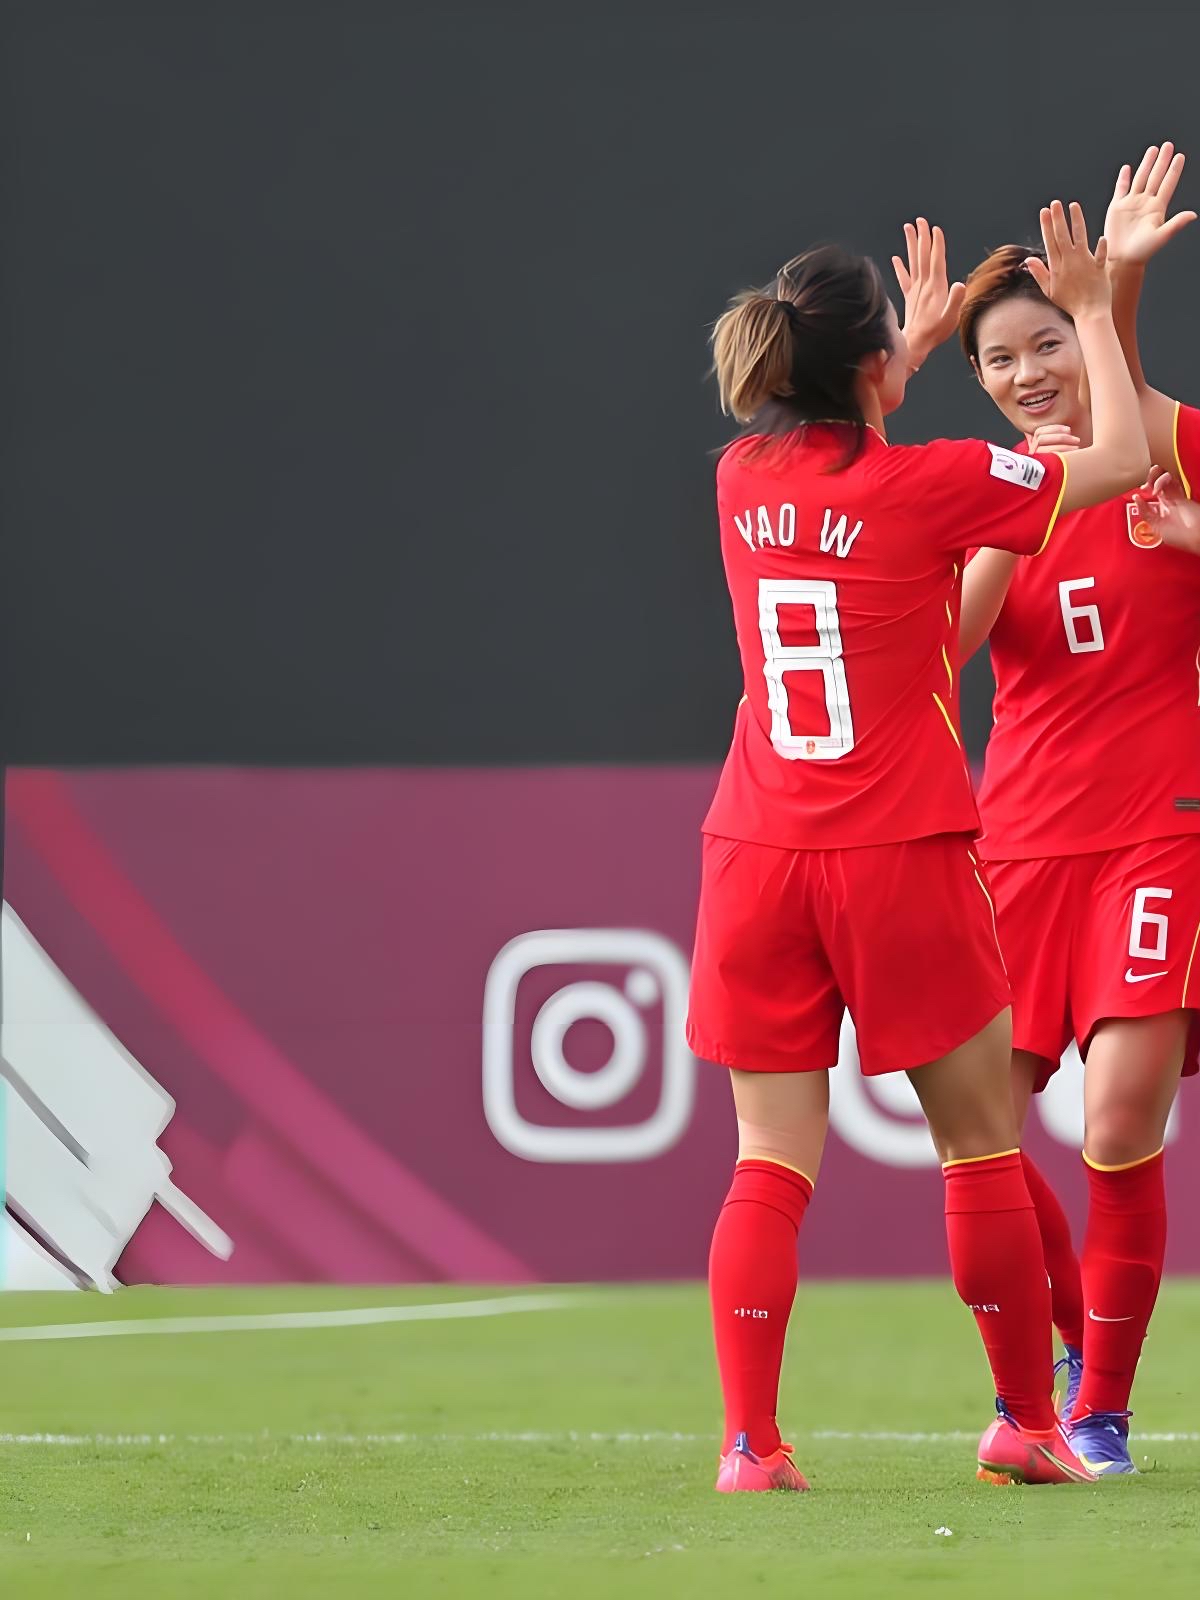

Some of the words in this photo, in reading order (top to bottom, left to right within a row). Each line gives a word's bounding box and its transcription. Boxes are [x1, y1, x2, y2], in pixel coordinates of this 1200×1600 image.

[733, 502, 796, 553] YAO
[819, 507, 863, 559] W
[1058, 576, 1105, 654] 6
[757, 578, 856, 761] 8
[1128, 886, 1174, 962] 6
